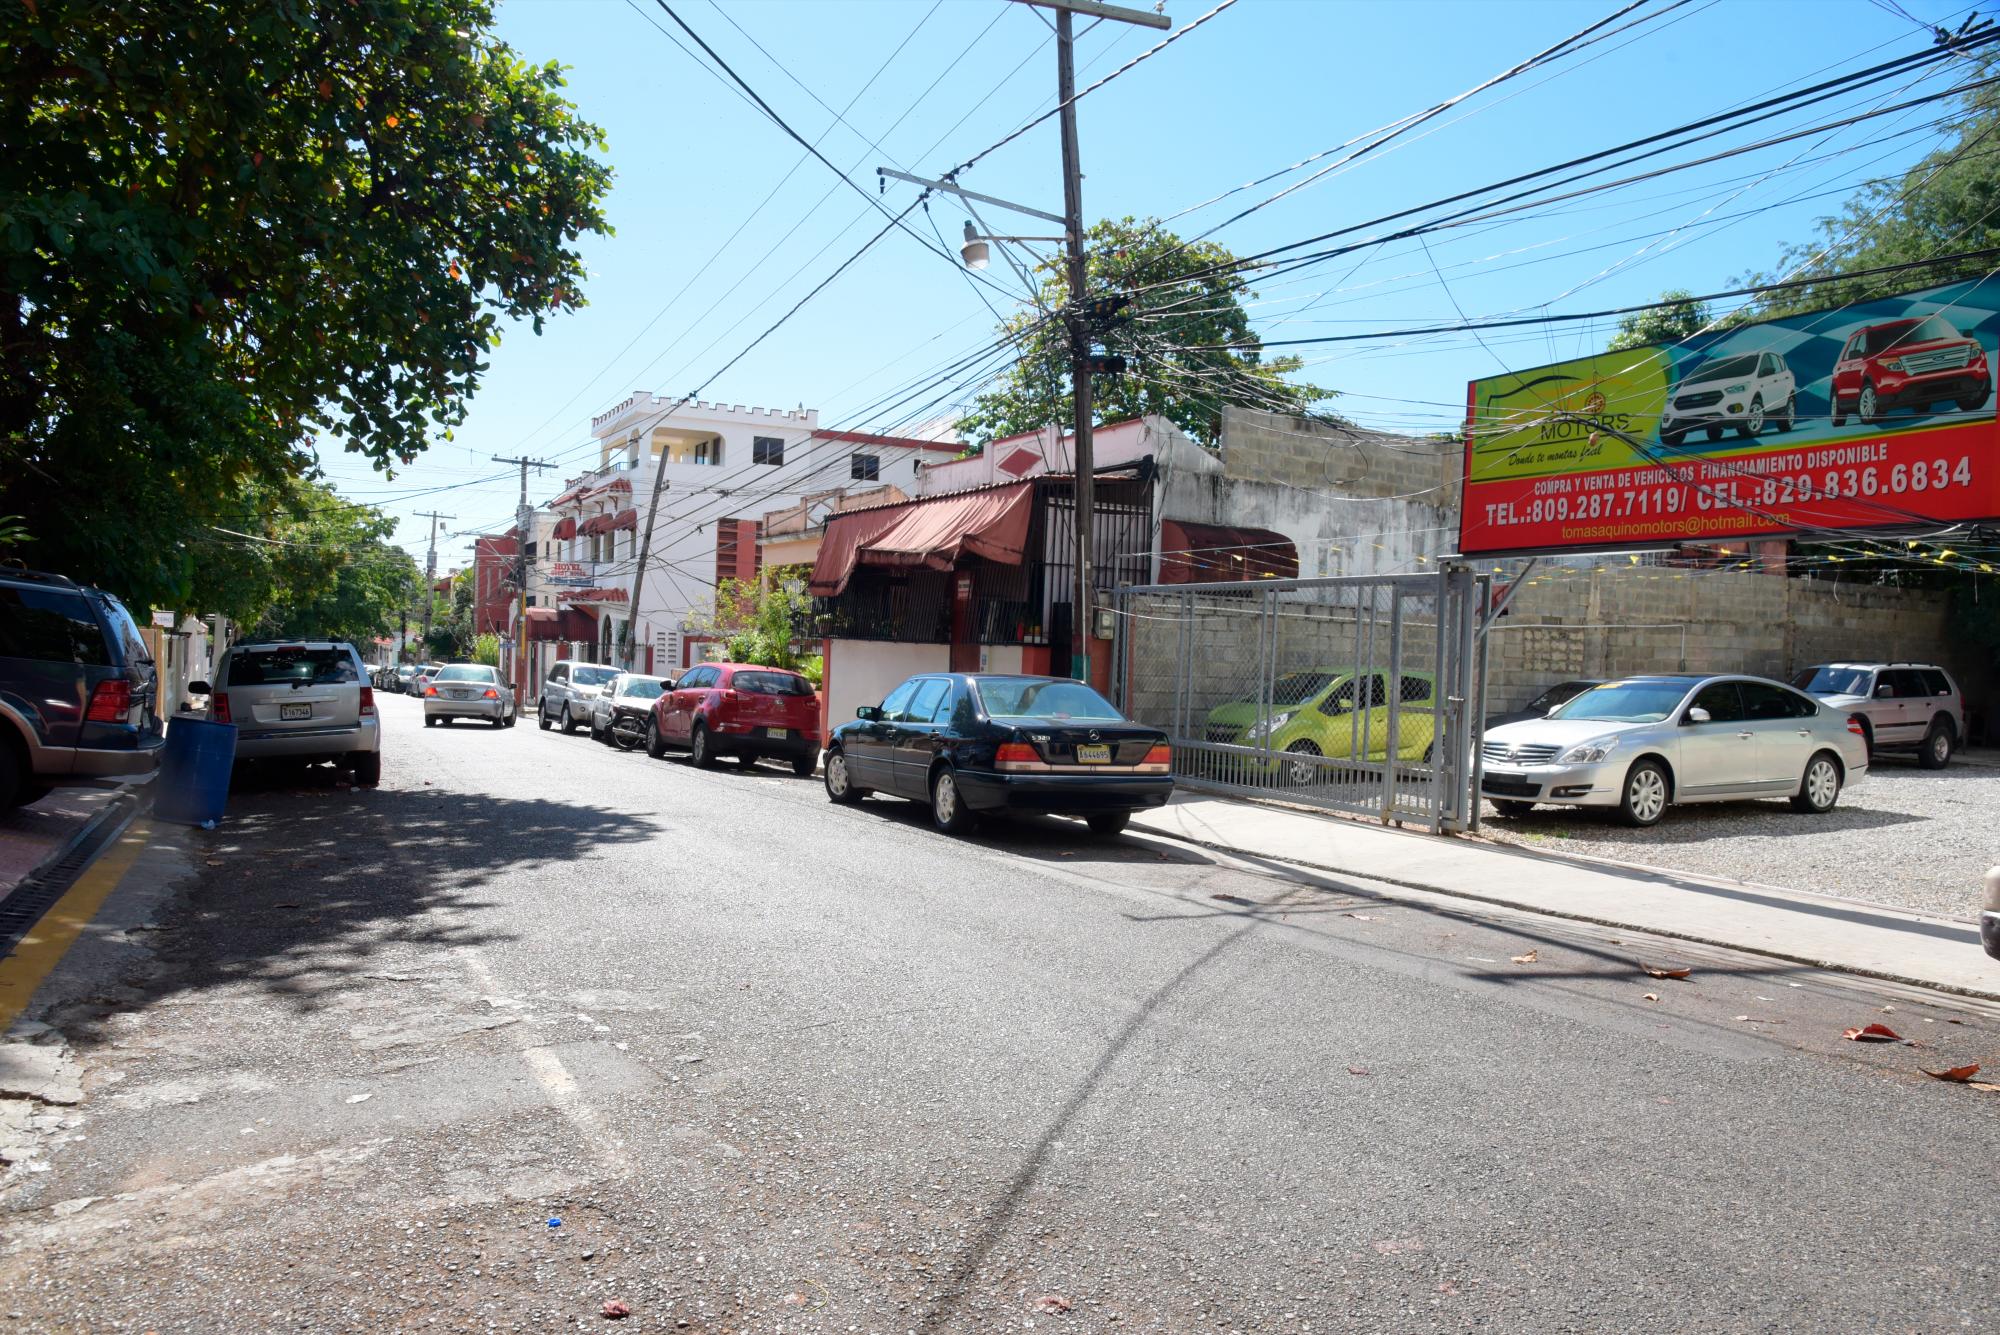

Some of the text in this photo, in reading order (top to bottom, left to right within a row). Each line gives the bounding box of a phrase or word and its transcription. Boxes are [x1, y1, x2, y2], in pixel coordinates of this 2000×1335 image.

[1540, 413, 1631, 440] MOTORS
[1508, 453, 1535, 467] Donde
[1536, 452, 1544, 463] te
[1547, 449, 1578, 462] montas
[1534, 443, 1888, 496] COMPRA Y VENTA DE VEHICULOS FINANCIAMIENTO DISPONIBLE
[1697, 456, 1972, 511] CEL.:829.836.6834
[1562, 512, 1791, 540] tomasaquinomotors@hotmail.com
[554, 563, 581, 571] HOTEL
